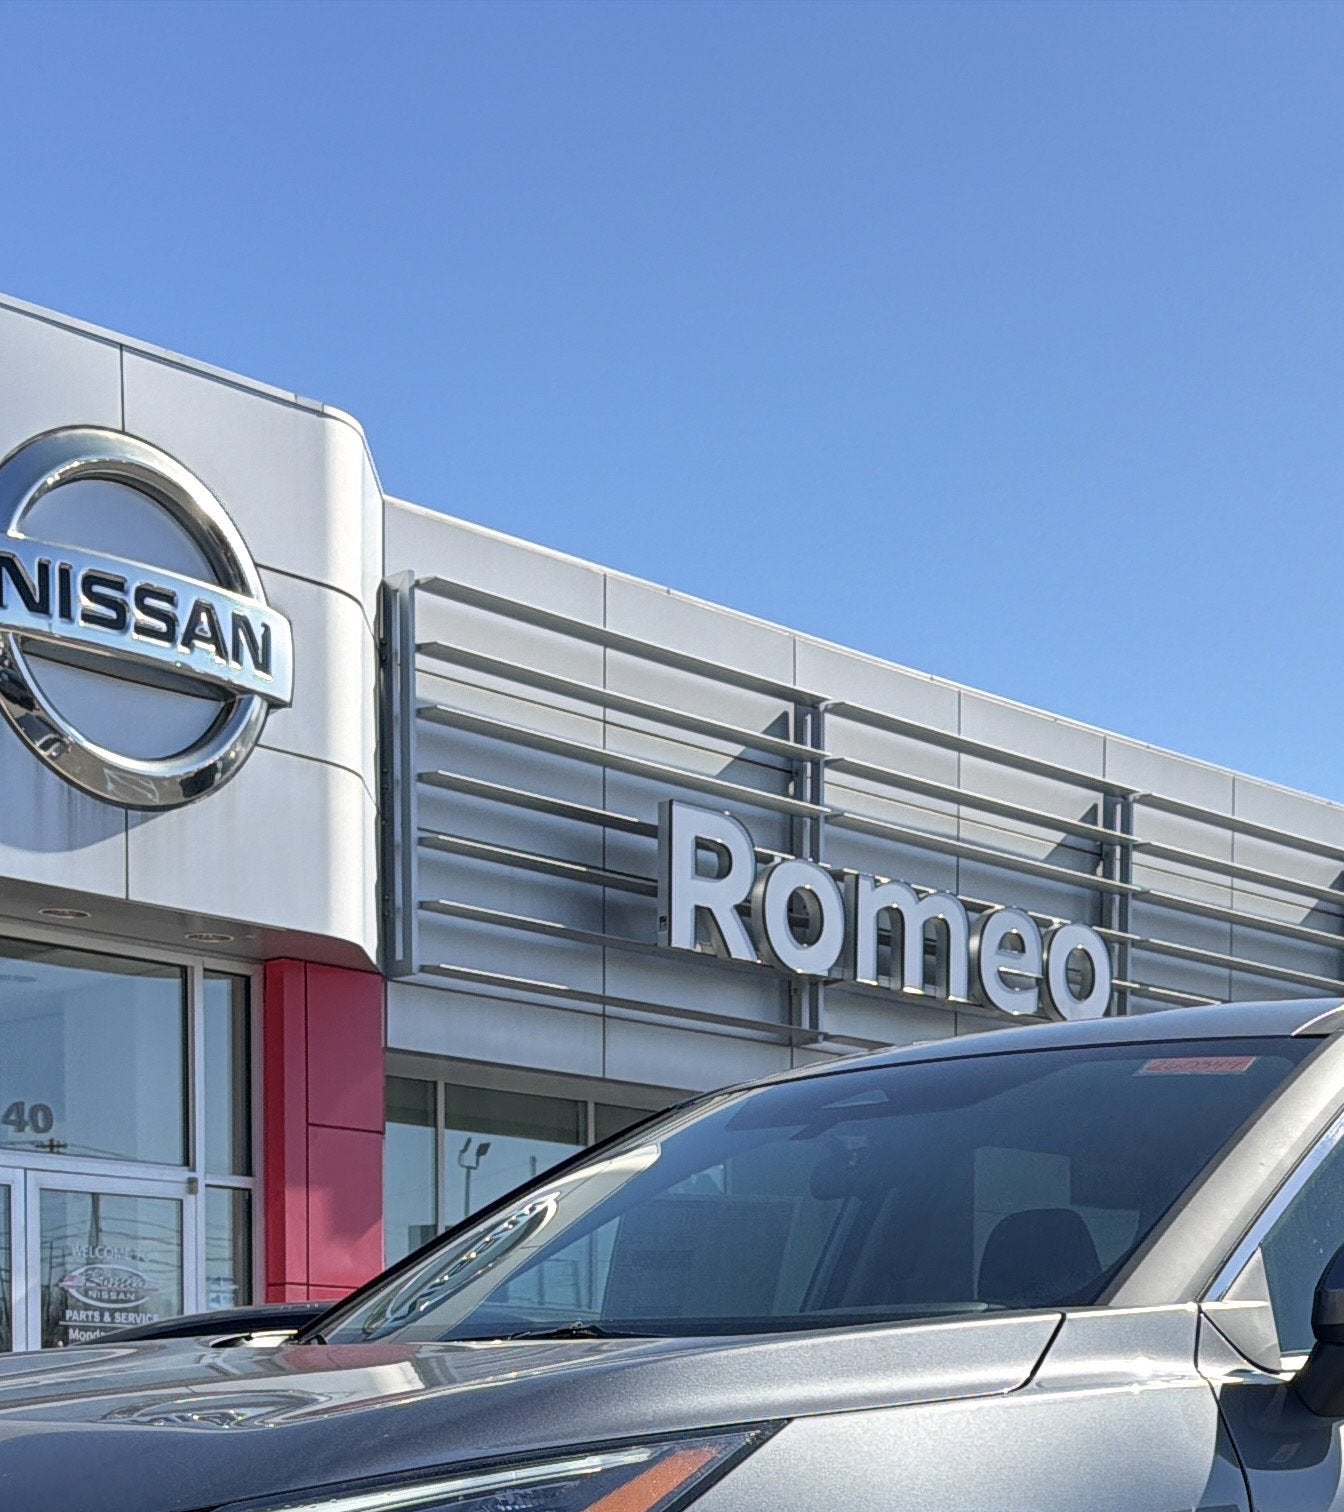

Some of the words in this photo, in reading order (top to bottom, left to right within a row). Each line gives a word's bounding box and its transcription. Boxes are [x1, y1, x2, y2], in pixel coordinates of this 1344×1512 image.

[659, 799, 1113, 1021] Romeo
[87, 1290, 136, 1301] NISSAN
[65, 1309, 101, 1323] PARTS
[102, 1311, 112, 1323] &
